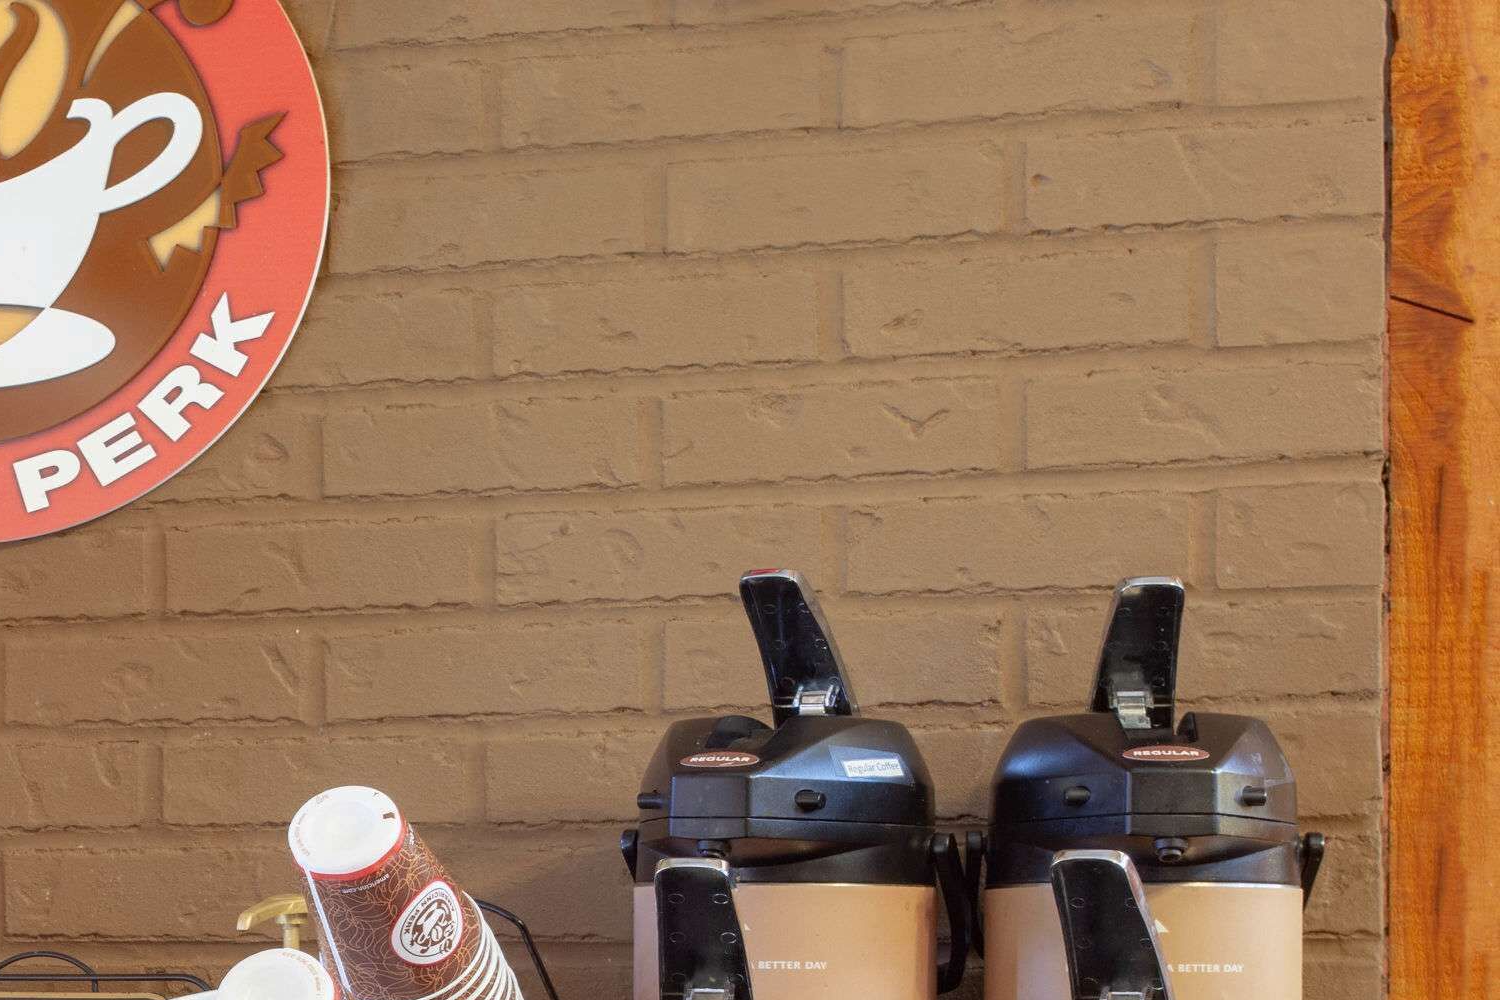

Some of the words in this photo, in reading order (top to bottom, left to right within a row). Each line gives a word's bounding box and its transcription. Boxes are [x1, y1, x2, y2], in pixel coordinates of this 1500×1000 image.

[14, 291, 276, 513] PERK
[690, 755, 750, 763] REGULAR
[758, 961, 800, 970] BETTER
[804, 961, 828, 970] DAY
[1178, 964, 1220, 973] BETTER
[1223, 964, 1244, 973] DAY
